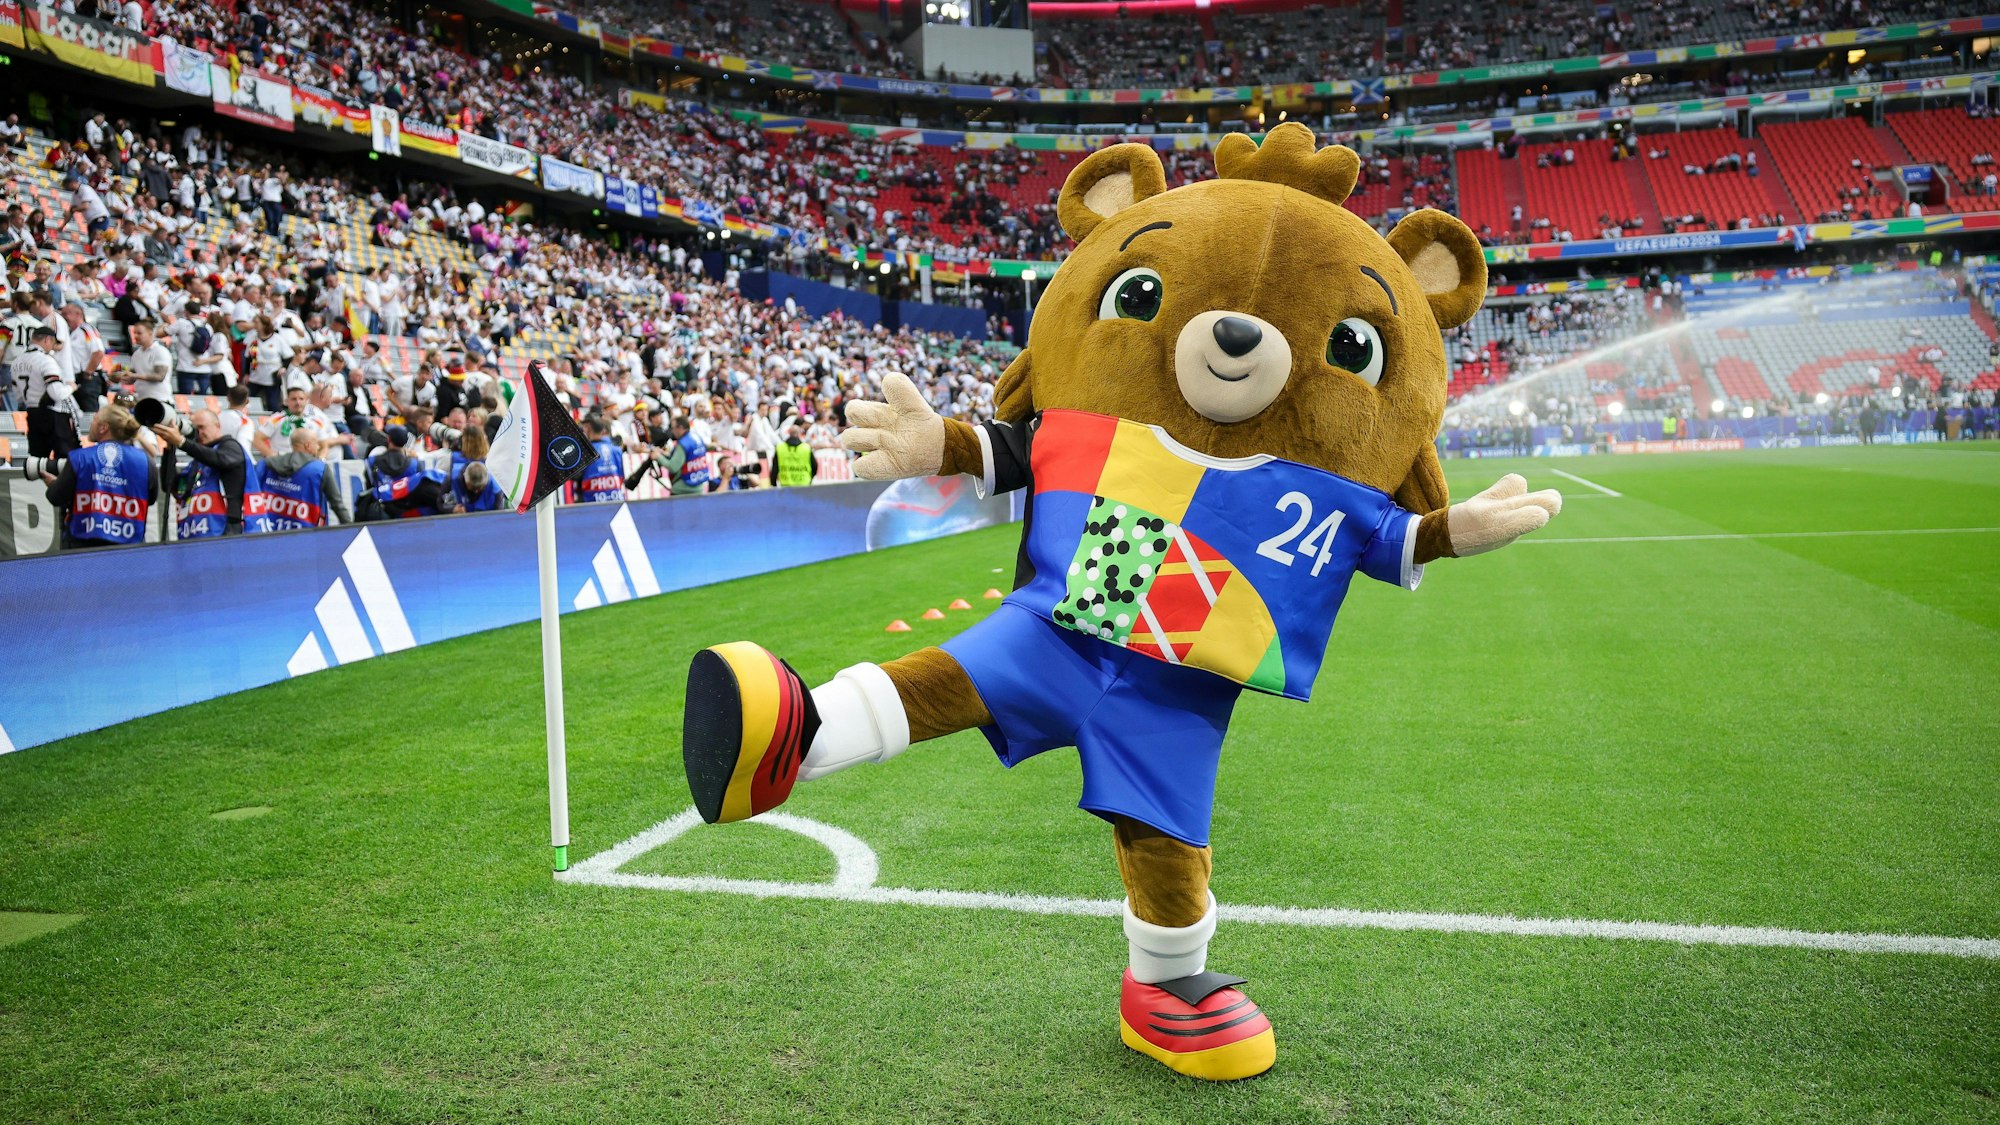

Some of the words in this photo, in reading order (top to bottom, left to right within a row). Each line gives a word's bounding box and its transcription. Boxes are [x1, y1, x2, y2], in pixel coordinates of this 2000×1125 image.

[76, 491, 140, 517] PHOTO
[249, 494, 309, 519] PHOTO
[1256, 490, 1347, 578] 24
